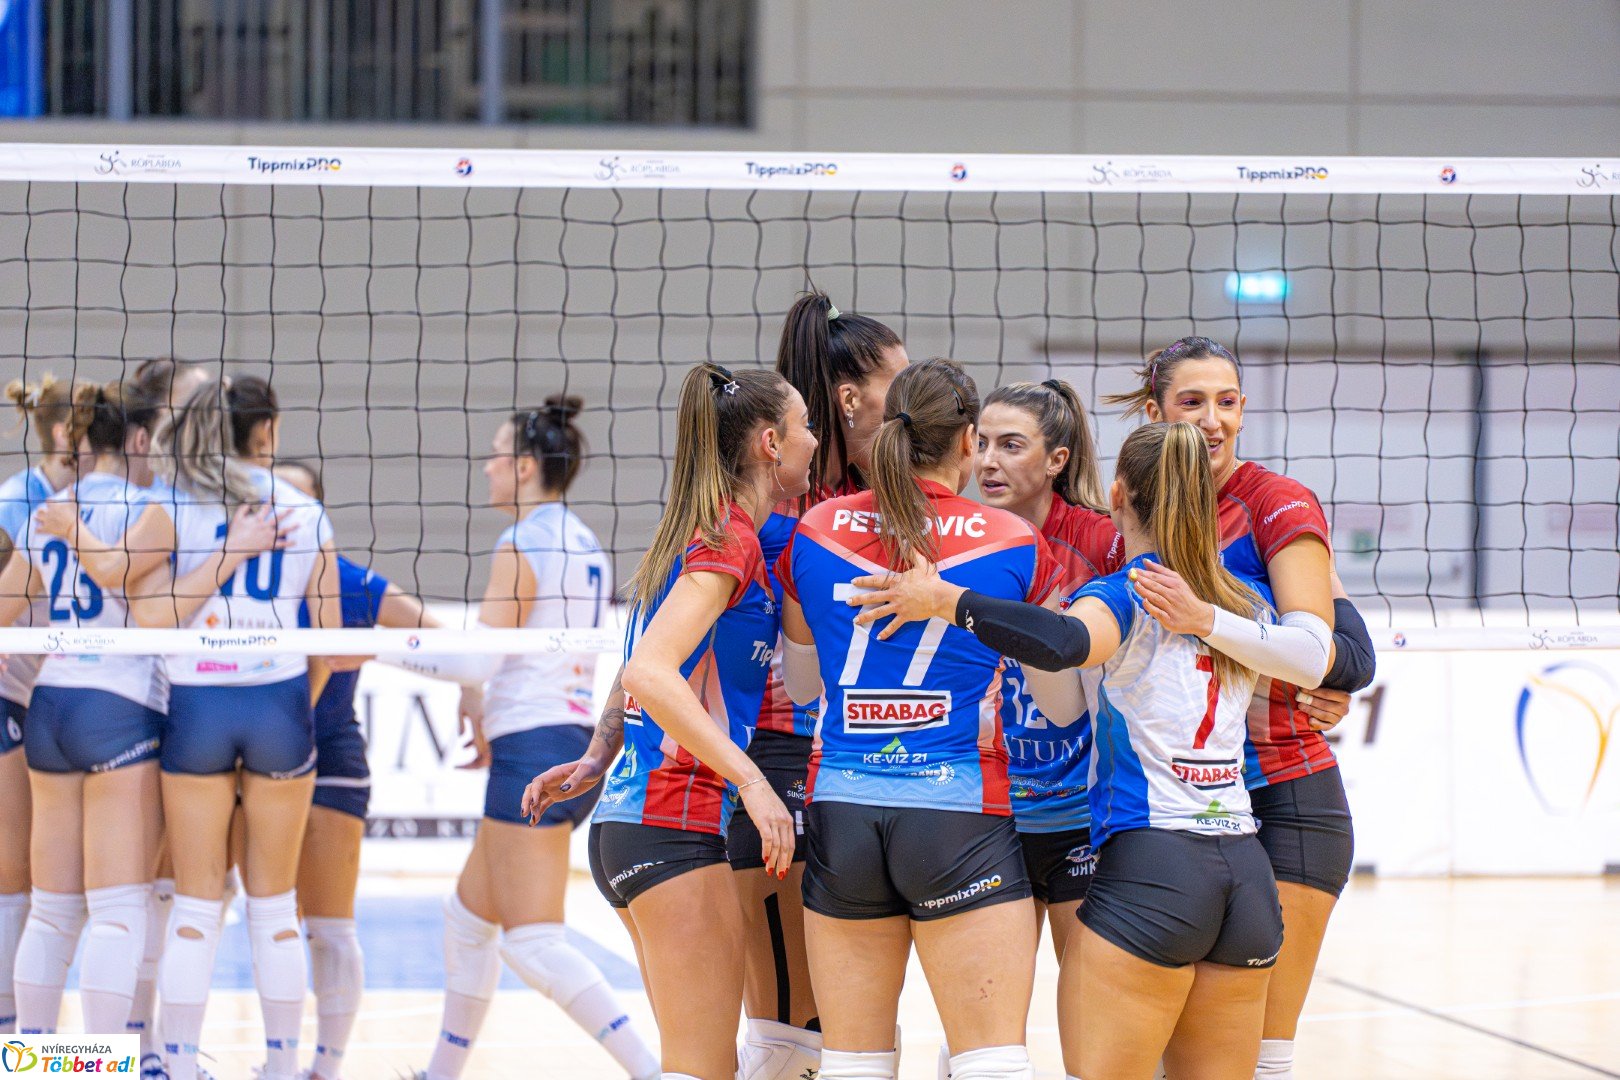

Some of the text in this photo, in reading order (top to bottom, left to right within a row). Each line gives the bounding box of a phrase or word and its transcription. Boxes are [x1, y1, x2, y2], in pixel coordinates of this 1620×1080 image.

[248, 156, 342, 174] TippmixPRO
[745, 162, 838, 178] TippmixPRO
[1236, 166, 1329, 182] TippmixPRO
[199, 636, 278, 649] TippmixPRO
[1194, 653, 1222, 750] 7
[846, 703, 947, 721] STRABAG
[1003, 732, 1085, 762] ATUM
[912, 752, 928, 764] 21
[1171, 764, 1240, 783] STRABAG
[918, 874, 1002, 909] ippmixPRO
